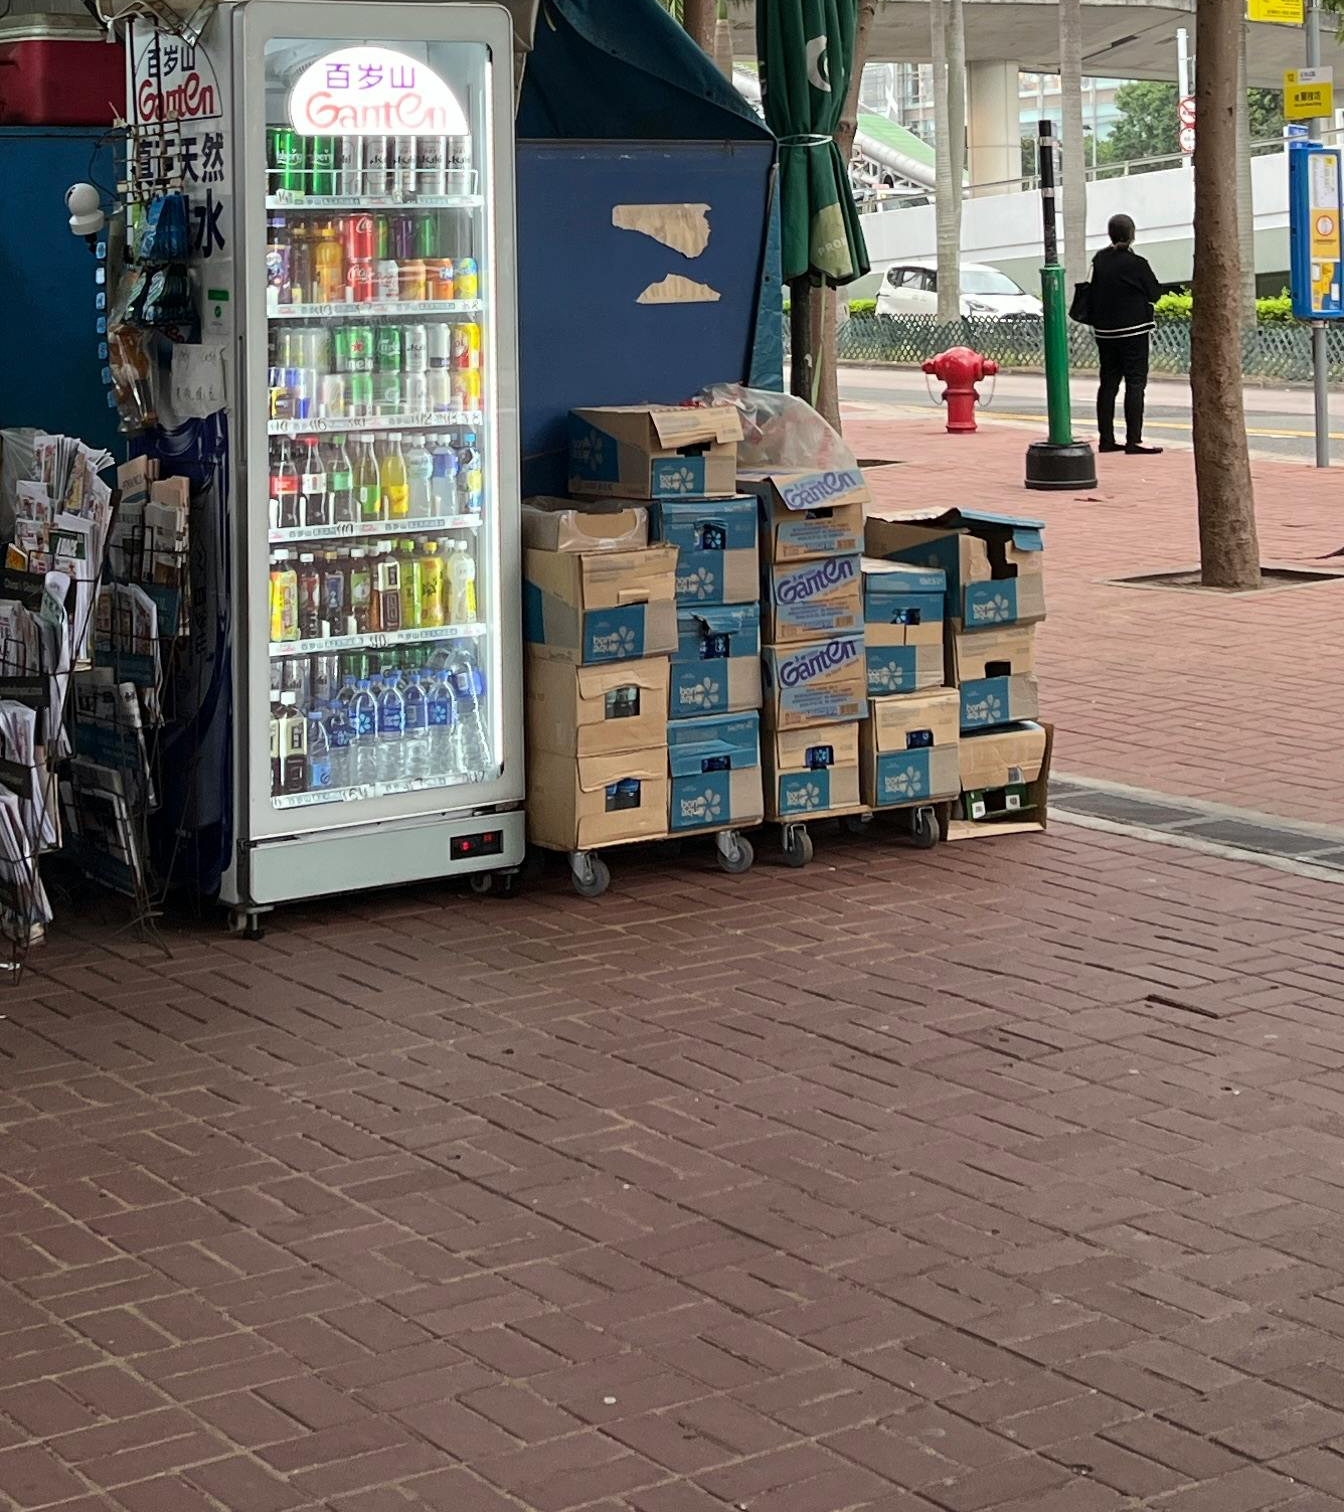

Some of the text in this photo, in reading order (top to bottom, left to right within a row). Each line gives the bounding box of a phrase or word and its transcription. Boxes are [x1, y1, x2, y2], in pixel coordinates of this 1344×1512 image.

[147, 44, 196, 79] 百岁山
[325, 62, 415, 90] 百岁山
